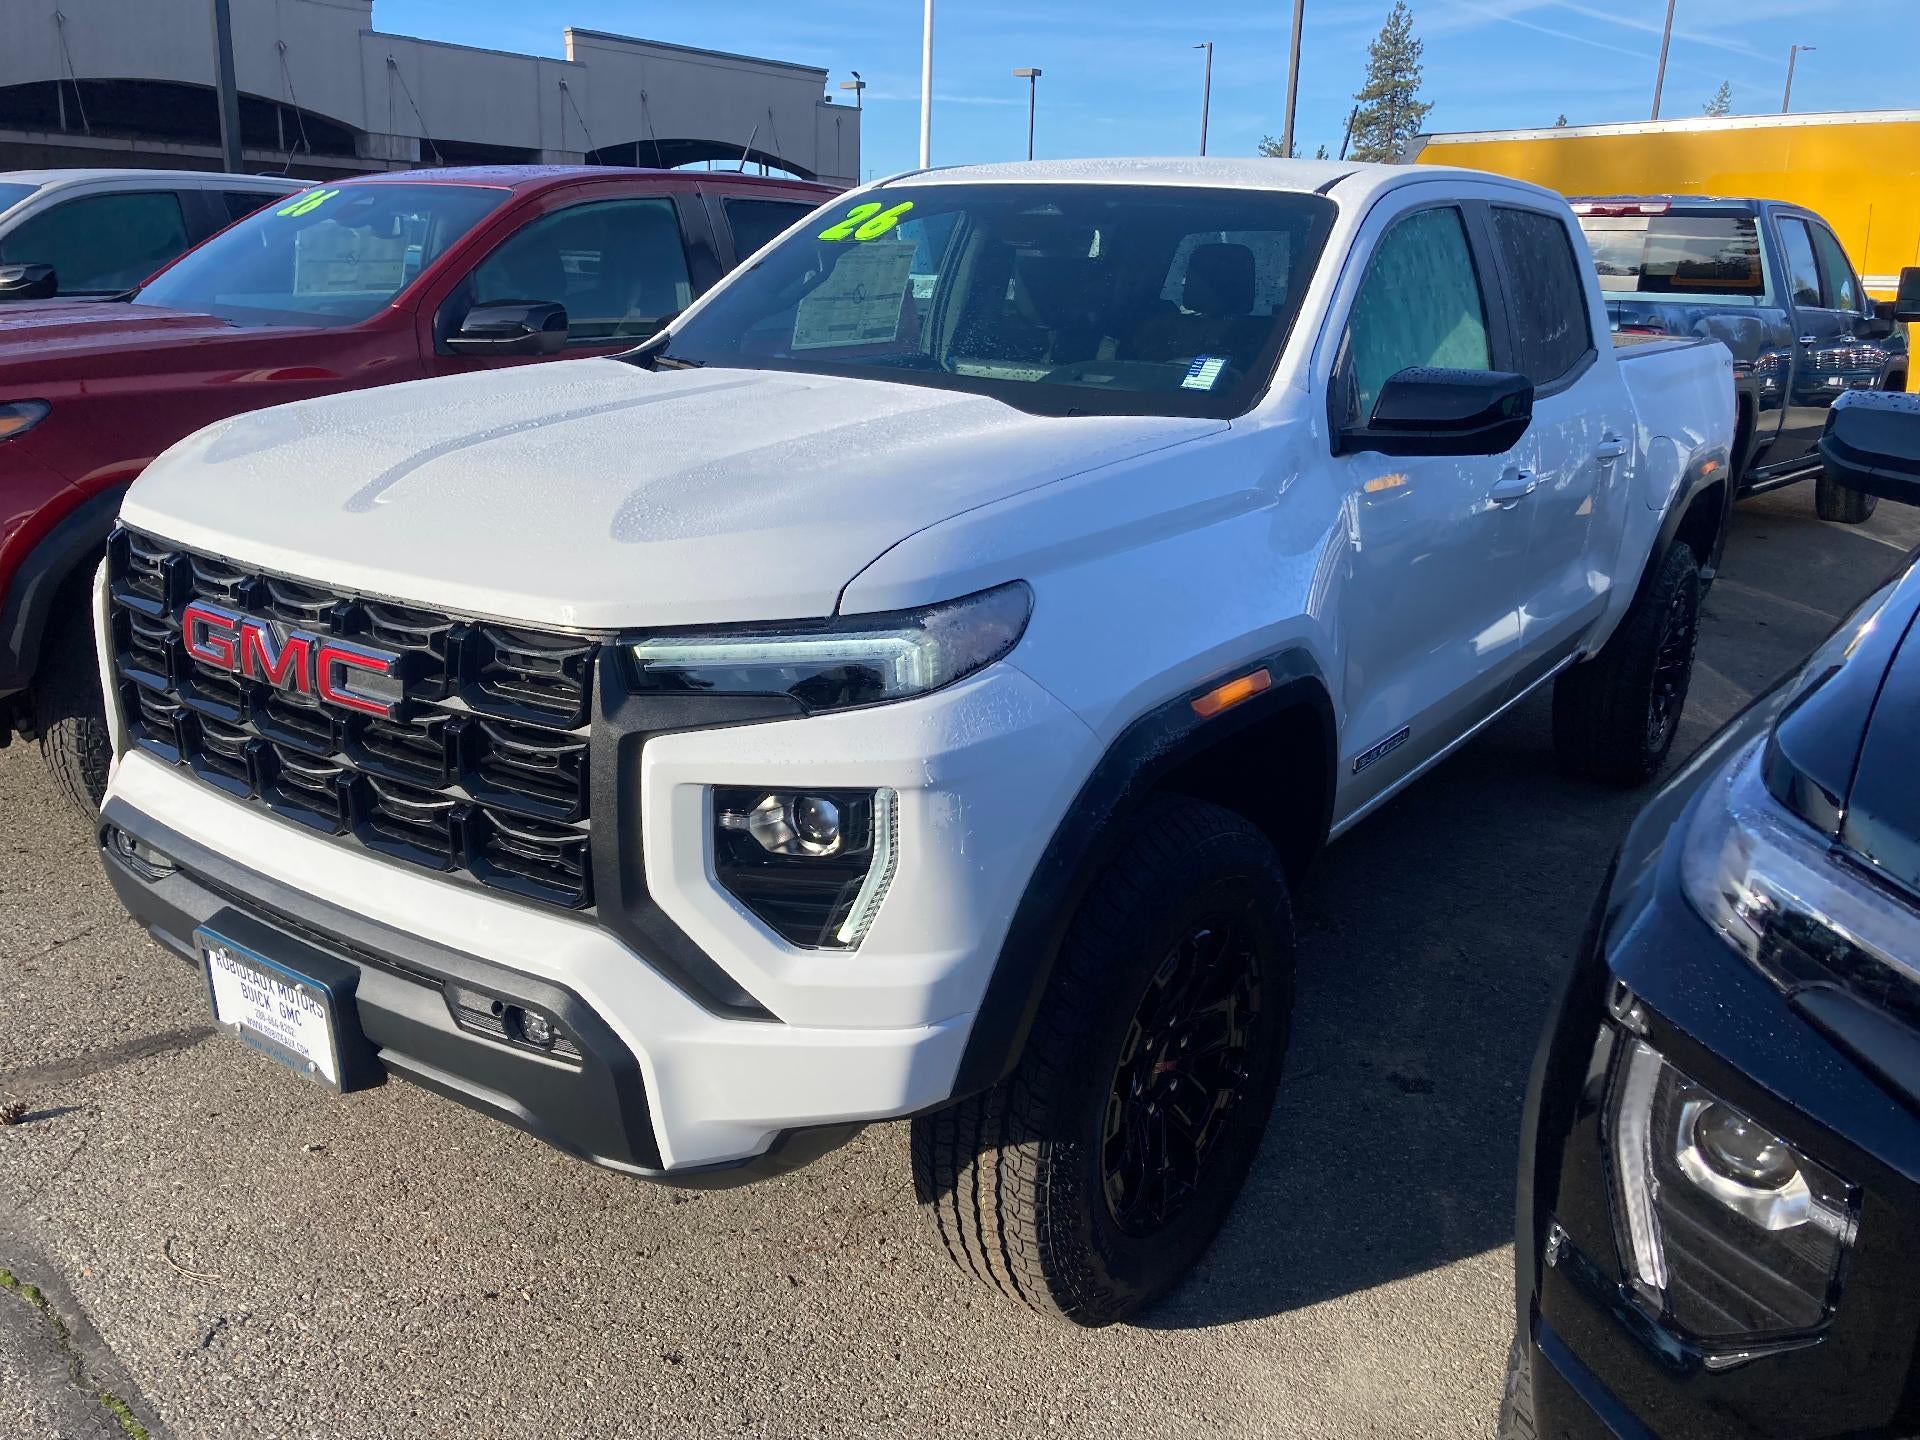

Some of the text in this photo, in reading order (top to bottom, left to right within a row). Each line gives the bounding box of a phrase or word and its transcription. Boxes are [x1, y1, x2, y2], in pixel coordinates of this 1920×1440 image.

[276, 189, 340, 217] 26
[817, 201, 914, 241] 26
[183, 602, 394, 718] GMC
[216, 953, 324, 1018] ROBIDEAUX MOTORS
[240, 982, 302, 1027] BUICK GMC
